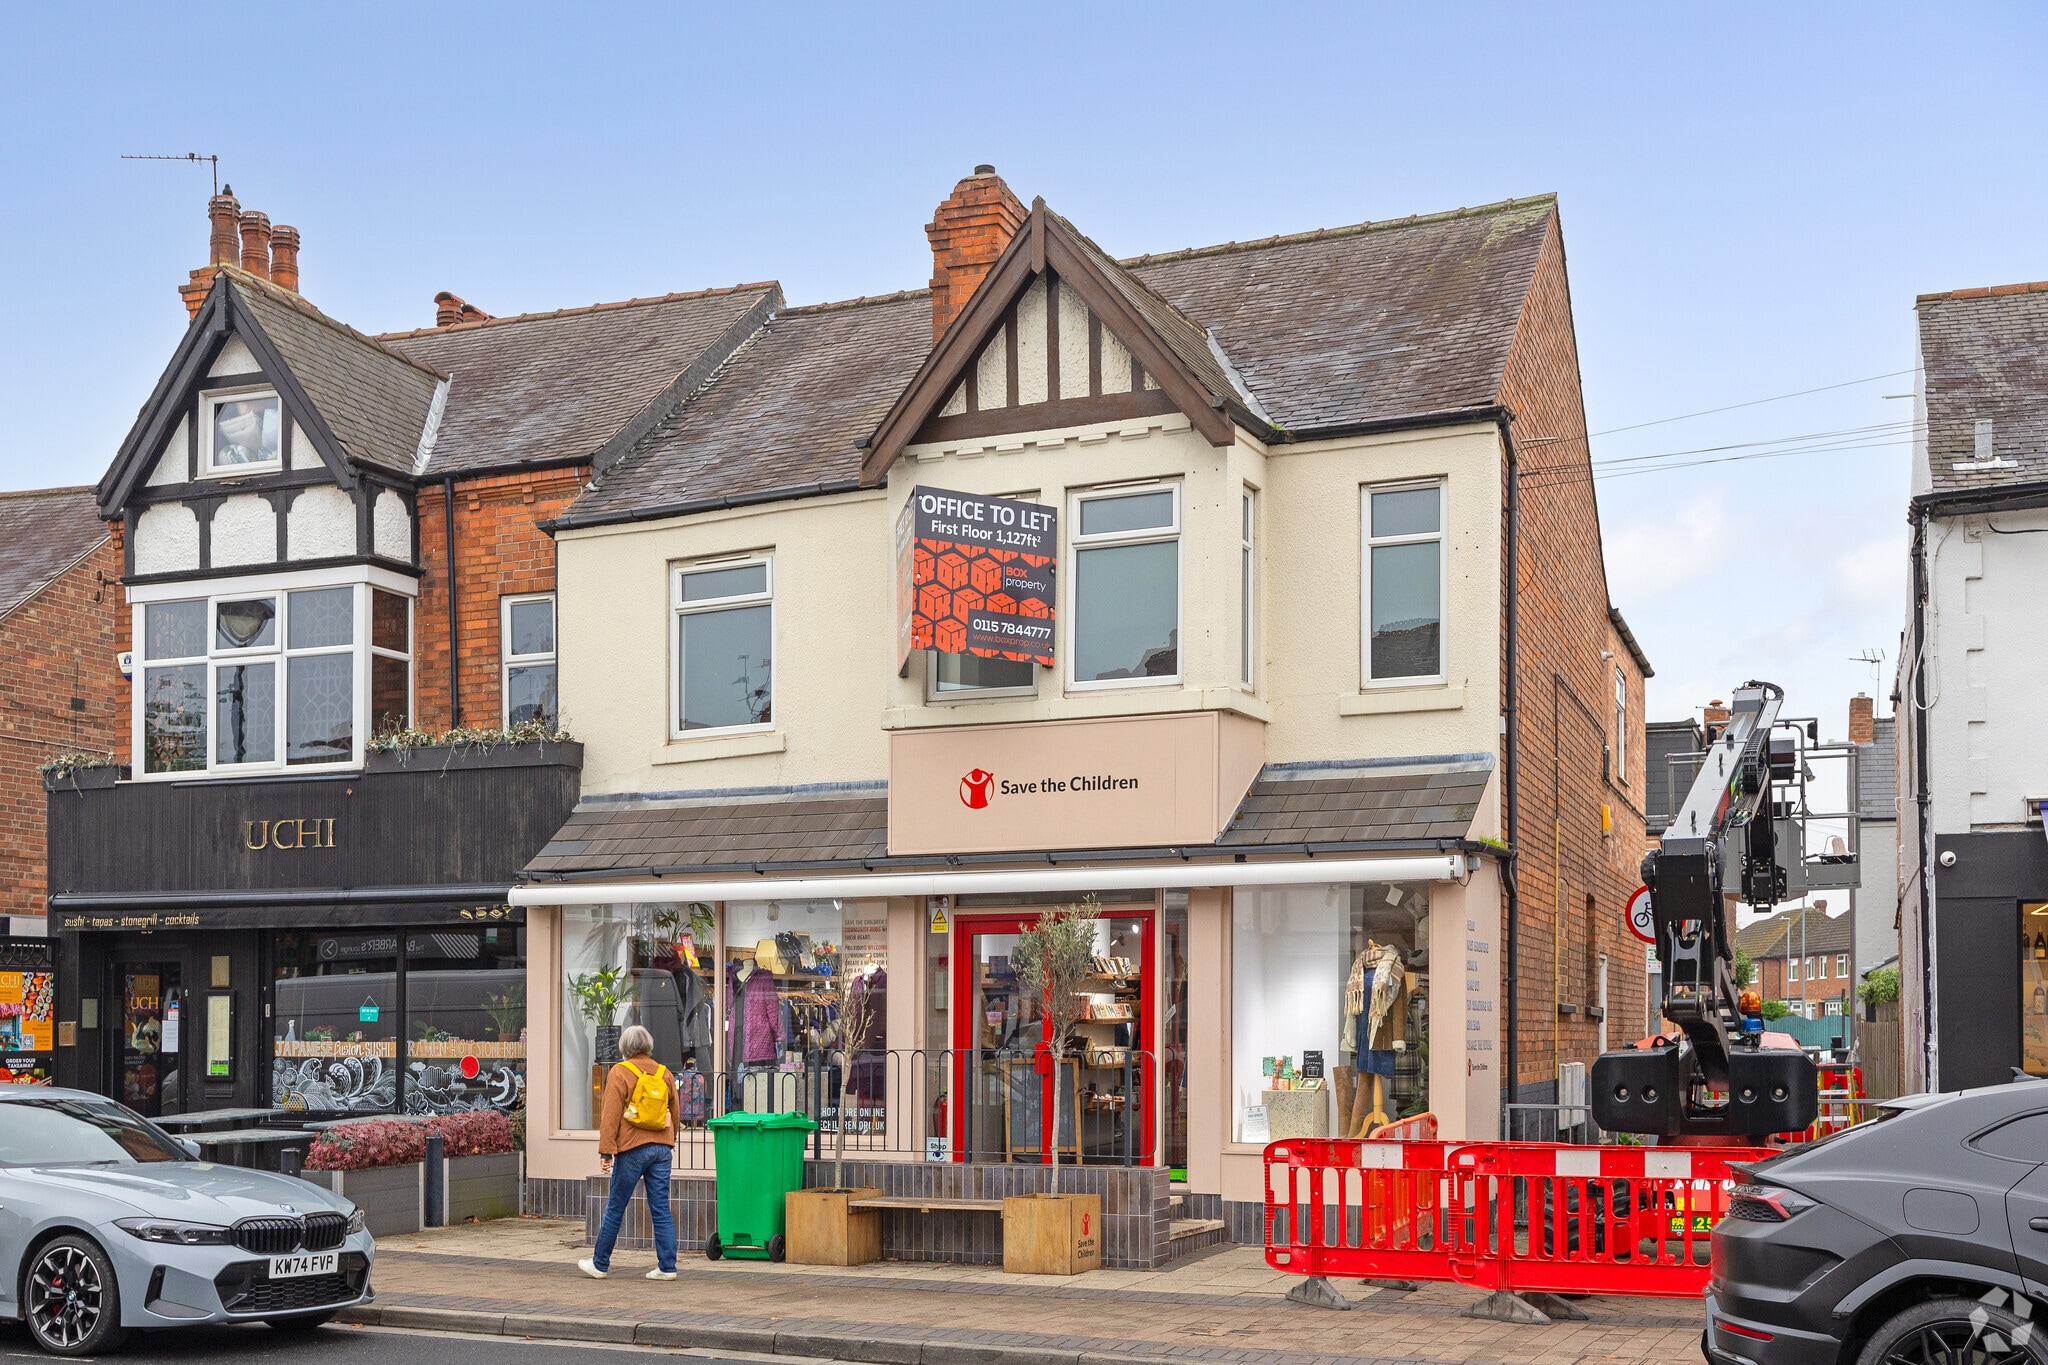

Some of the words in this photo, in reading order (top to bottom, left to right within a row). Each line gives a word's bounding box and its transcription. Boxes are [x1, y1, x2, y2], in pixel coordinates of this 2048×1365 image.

[921, 494, 984, 521] OFFICE
[989, 504, 1015, 526] TO
[1021, 510, 1052, 532] LET
[931, 519, 958, 535] First
[962, 524, 993, 540] Floor
[1005, 566, 1028, 578] BOX
[1005, 578, 1047, 592] property
[973, 619, 999, 632] 0115
[1001, 622, 1051, 639] 7844777
[972, 634, 1051, 649] www.boxprop.co.uk
[1000, 780, 1037, 795] Save
[1041, 778, 1066, 793] the
[1070, 775, 1139, 792] Children
[244, 818, 336, 850] UCHI
[64, 915, 86, 927] sushi
[92, 916, 113, 928] tapas
[121, 913, 158, 928] stonegrill
[165, 912, 200, 927] cocktails
[130, 996, 164, 1010] UCHI
[275, 1041, 333, 1057] JAPANESE
[365, 1041, 391, 1057] SUSHI
[406, 1040, 447, 1057] RAMEN
[930, 1142, 947, 1150] Shop
[1077, 1239, 1088, 1248] Save
[1087, 1238, 1095, 1246] the
[1077, 1249, 1095, 1259] Children
[275, 1257, 308, 1275] KW74
[311, 1255, 334, 1271] FVP
